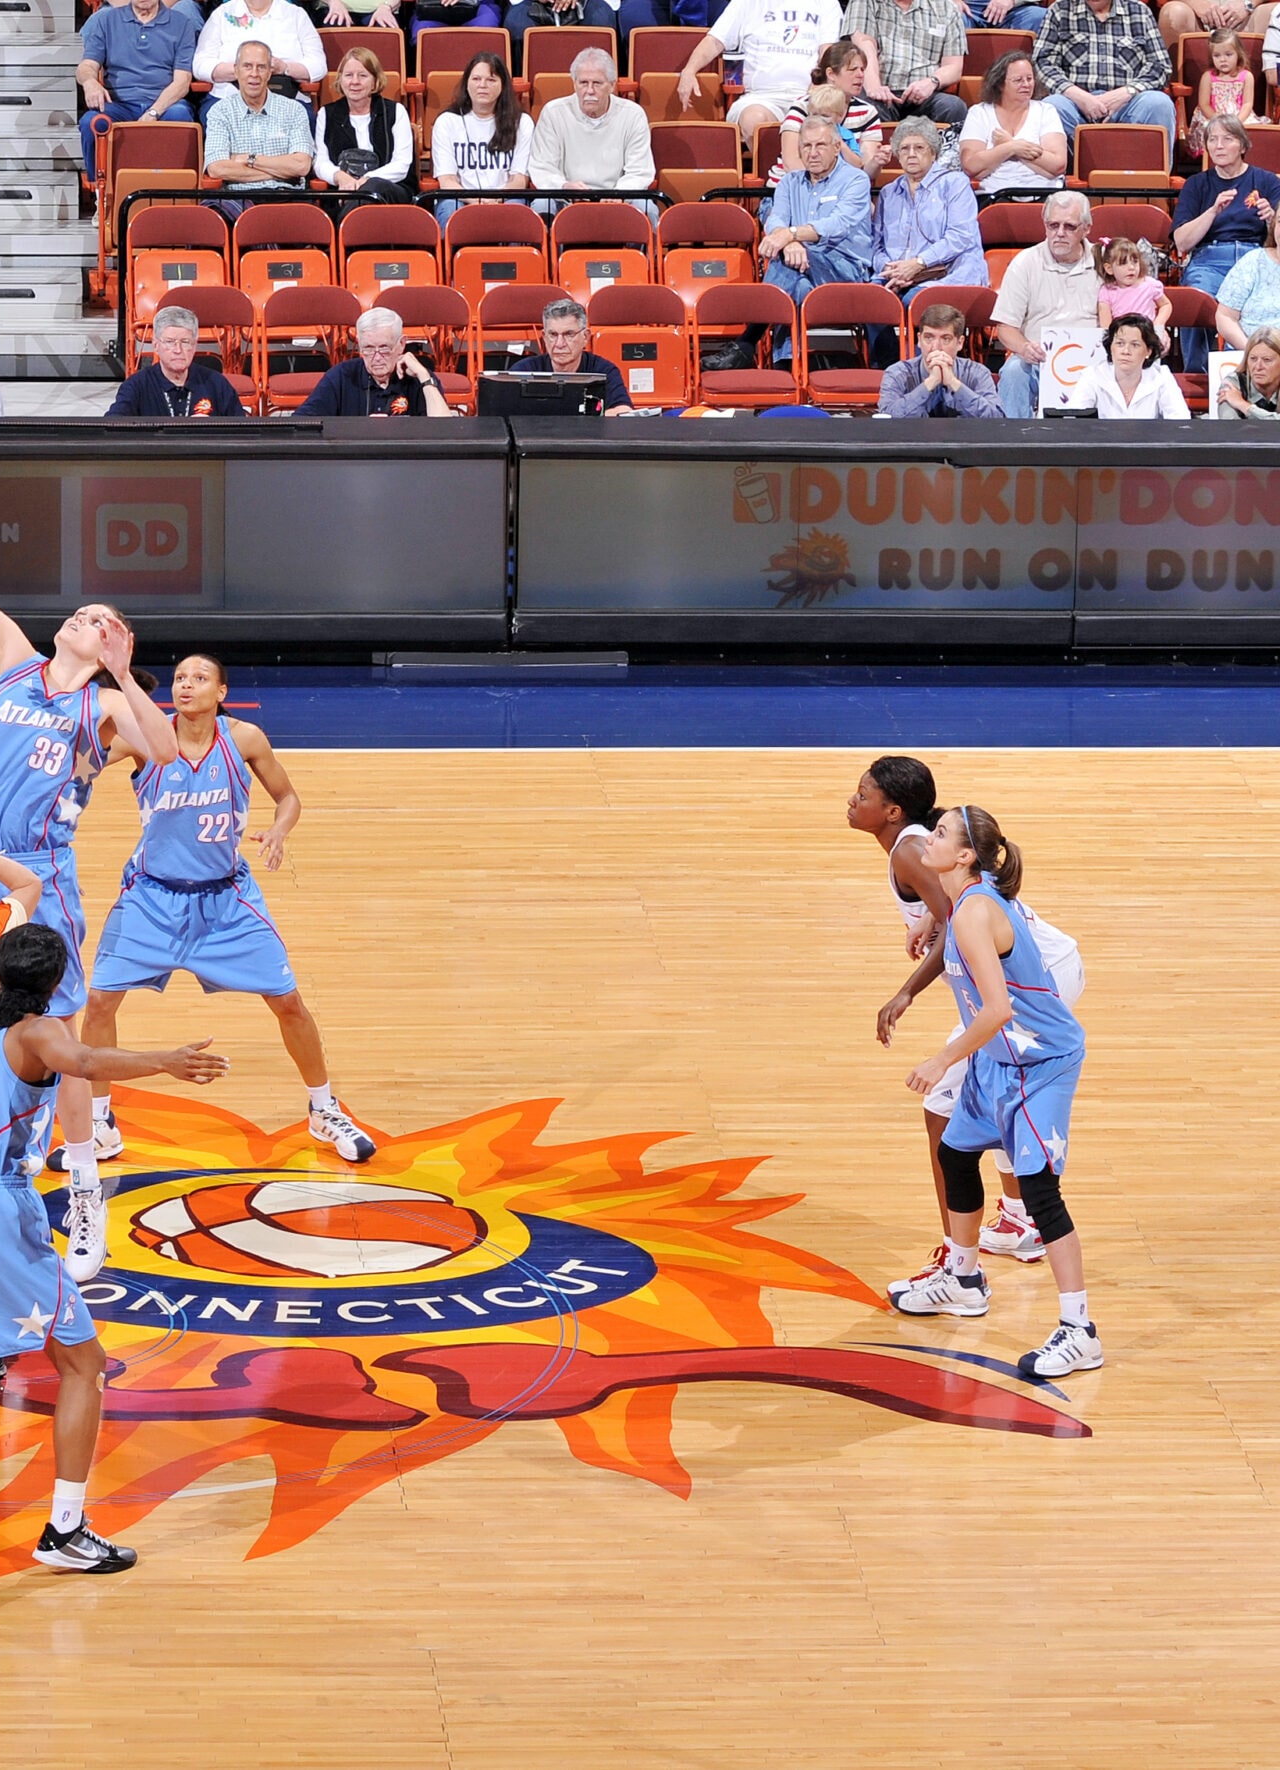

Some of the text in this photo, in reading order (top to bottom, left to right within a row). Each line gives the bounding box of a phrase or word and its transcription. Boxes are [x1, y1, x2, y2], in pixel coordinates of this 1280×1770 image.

[764, 10, 819, 25] SUN
[280, 264, 295, 277] 2
[387, 264, 400, 275] 3
[600, 264, 612, 275] 5
[703, 264, 713, 275] 6
[106, 519, 179, 557] DD
[878, 548, 1001, 592] RUN
[1028, 547, 1118, 592] ON
[28, 736, 68, 777] 33
[153, 788, 230, 812] ATLANTA
[197, 812, 231, 844] 22
